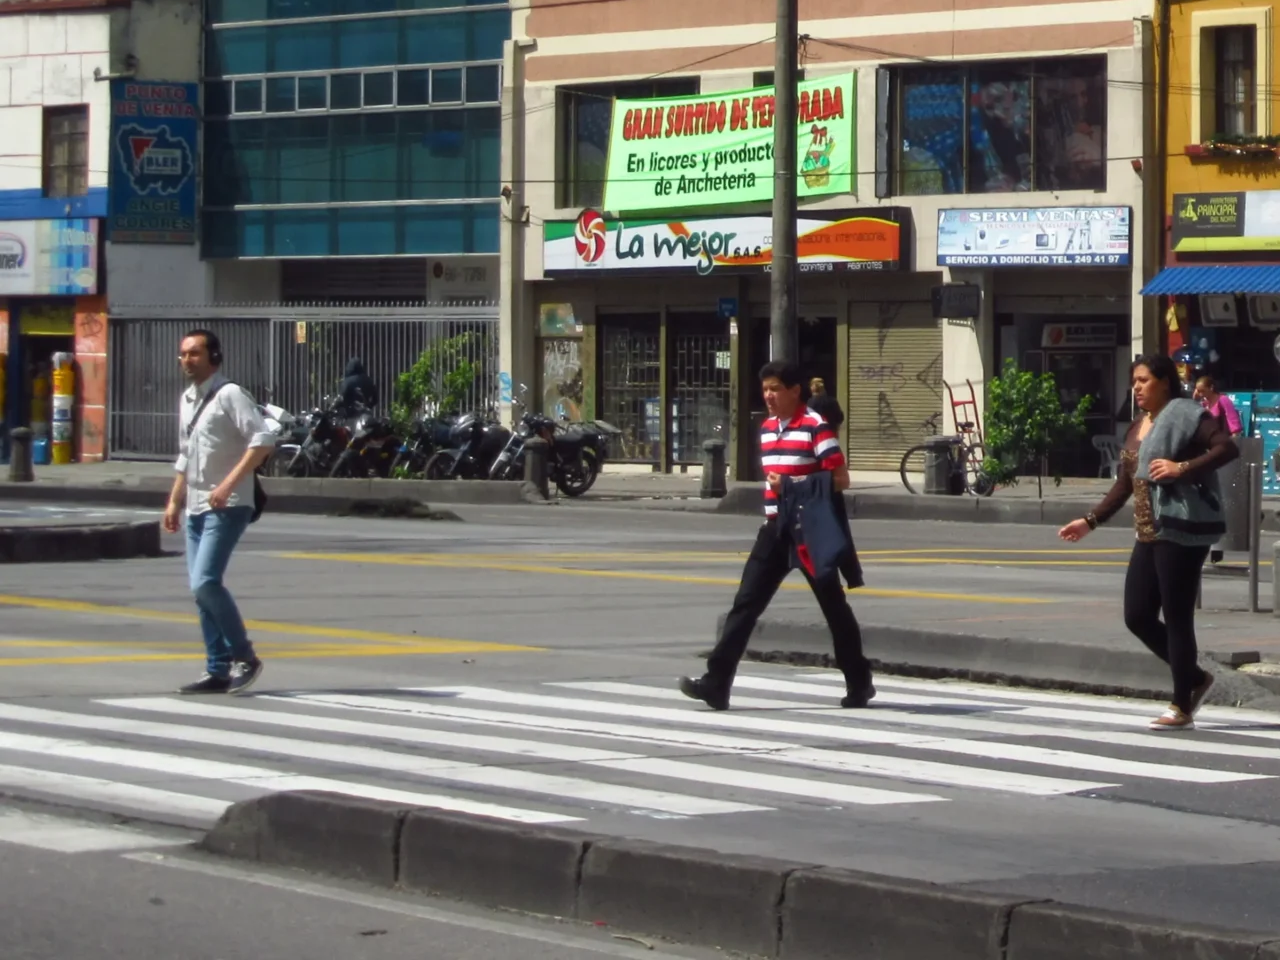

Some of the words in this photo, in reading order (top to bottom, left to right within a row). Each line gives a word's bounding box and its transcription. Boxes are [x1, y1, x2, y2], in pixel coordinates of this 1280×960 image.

[125, 84, 187, 101] PUNTO
[116, 101, 138, 116] DE
[142, 102, 197, 117] VENTA
[622, 106, 664, 141] GRAN
[666, 100, 727, 138] SURTIDO
[730, 97, 750, 131] DE
[627, 153, 645, 172] En
[650, 150, 697, 172] licores
[702, 151, 711, 172] y
[655, 176, 672, 196] de
[677, 168, 756, 194] Ancheteria
[129, 199, 180, 212] ANGIE
[1197, 204, 1237, 216] PRINCIPAL
[115, 216, 192, 229] COLORES
[969, 211, 1028, 222] SERVI
[1035, 209, 1115, 222] VENTAS
[615, 221, 645, 260] La
[653, 230, 737, 275] mejor
[946, 256, 988, 265] SERVICIO
[991, 256, 998, 264] A
[1000, 255, 1049, 264] DOMICILIO
[1052, 255, 1072, 264] TEL.
[1075, 255, 1092, 263] 249
[1094, 255, 1105, 263] 41
[1108, 255, 1120, 263] 97
